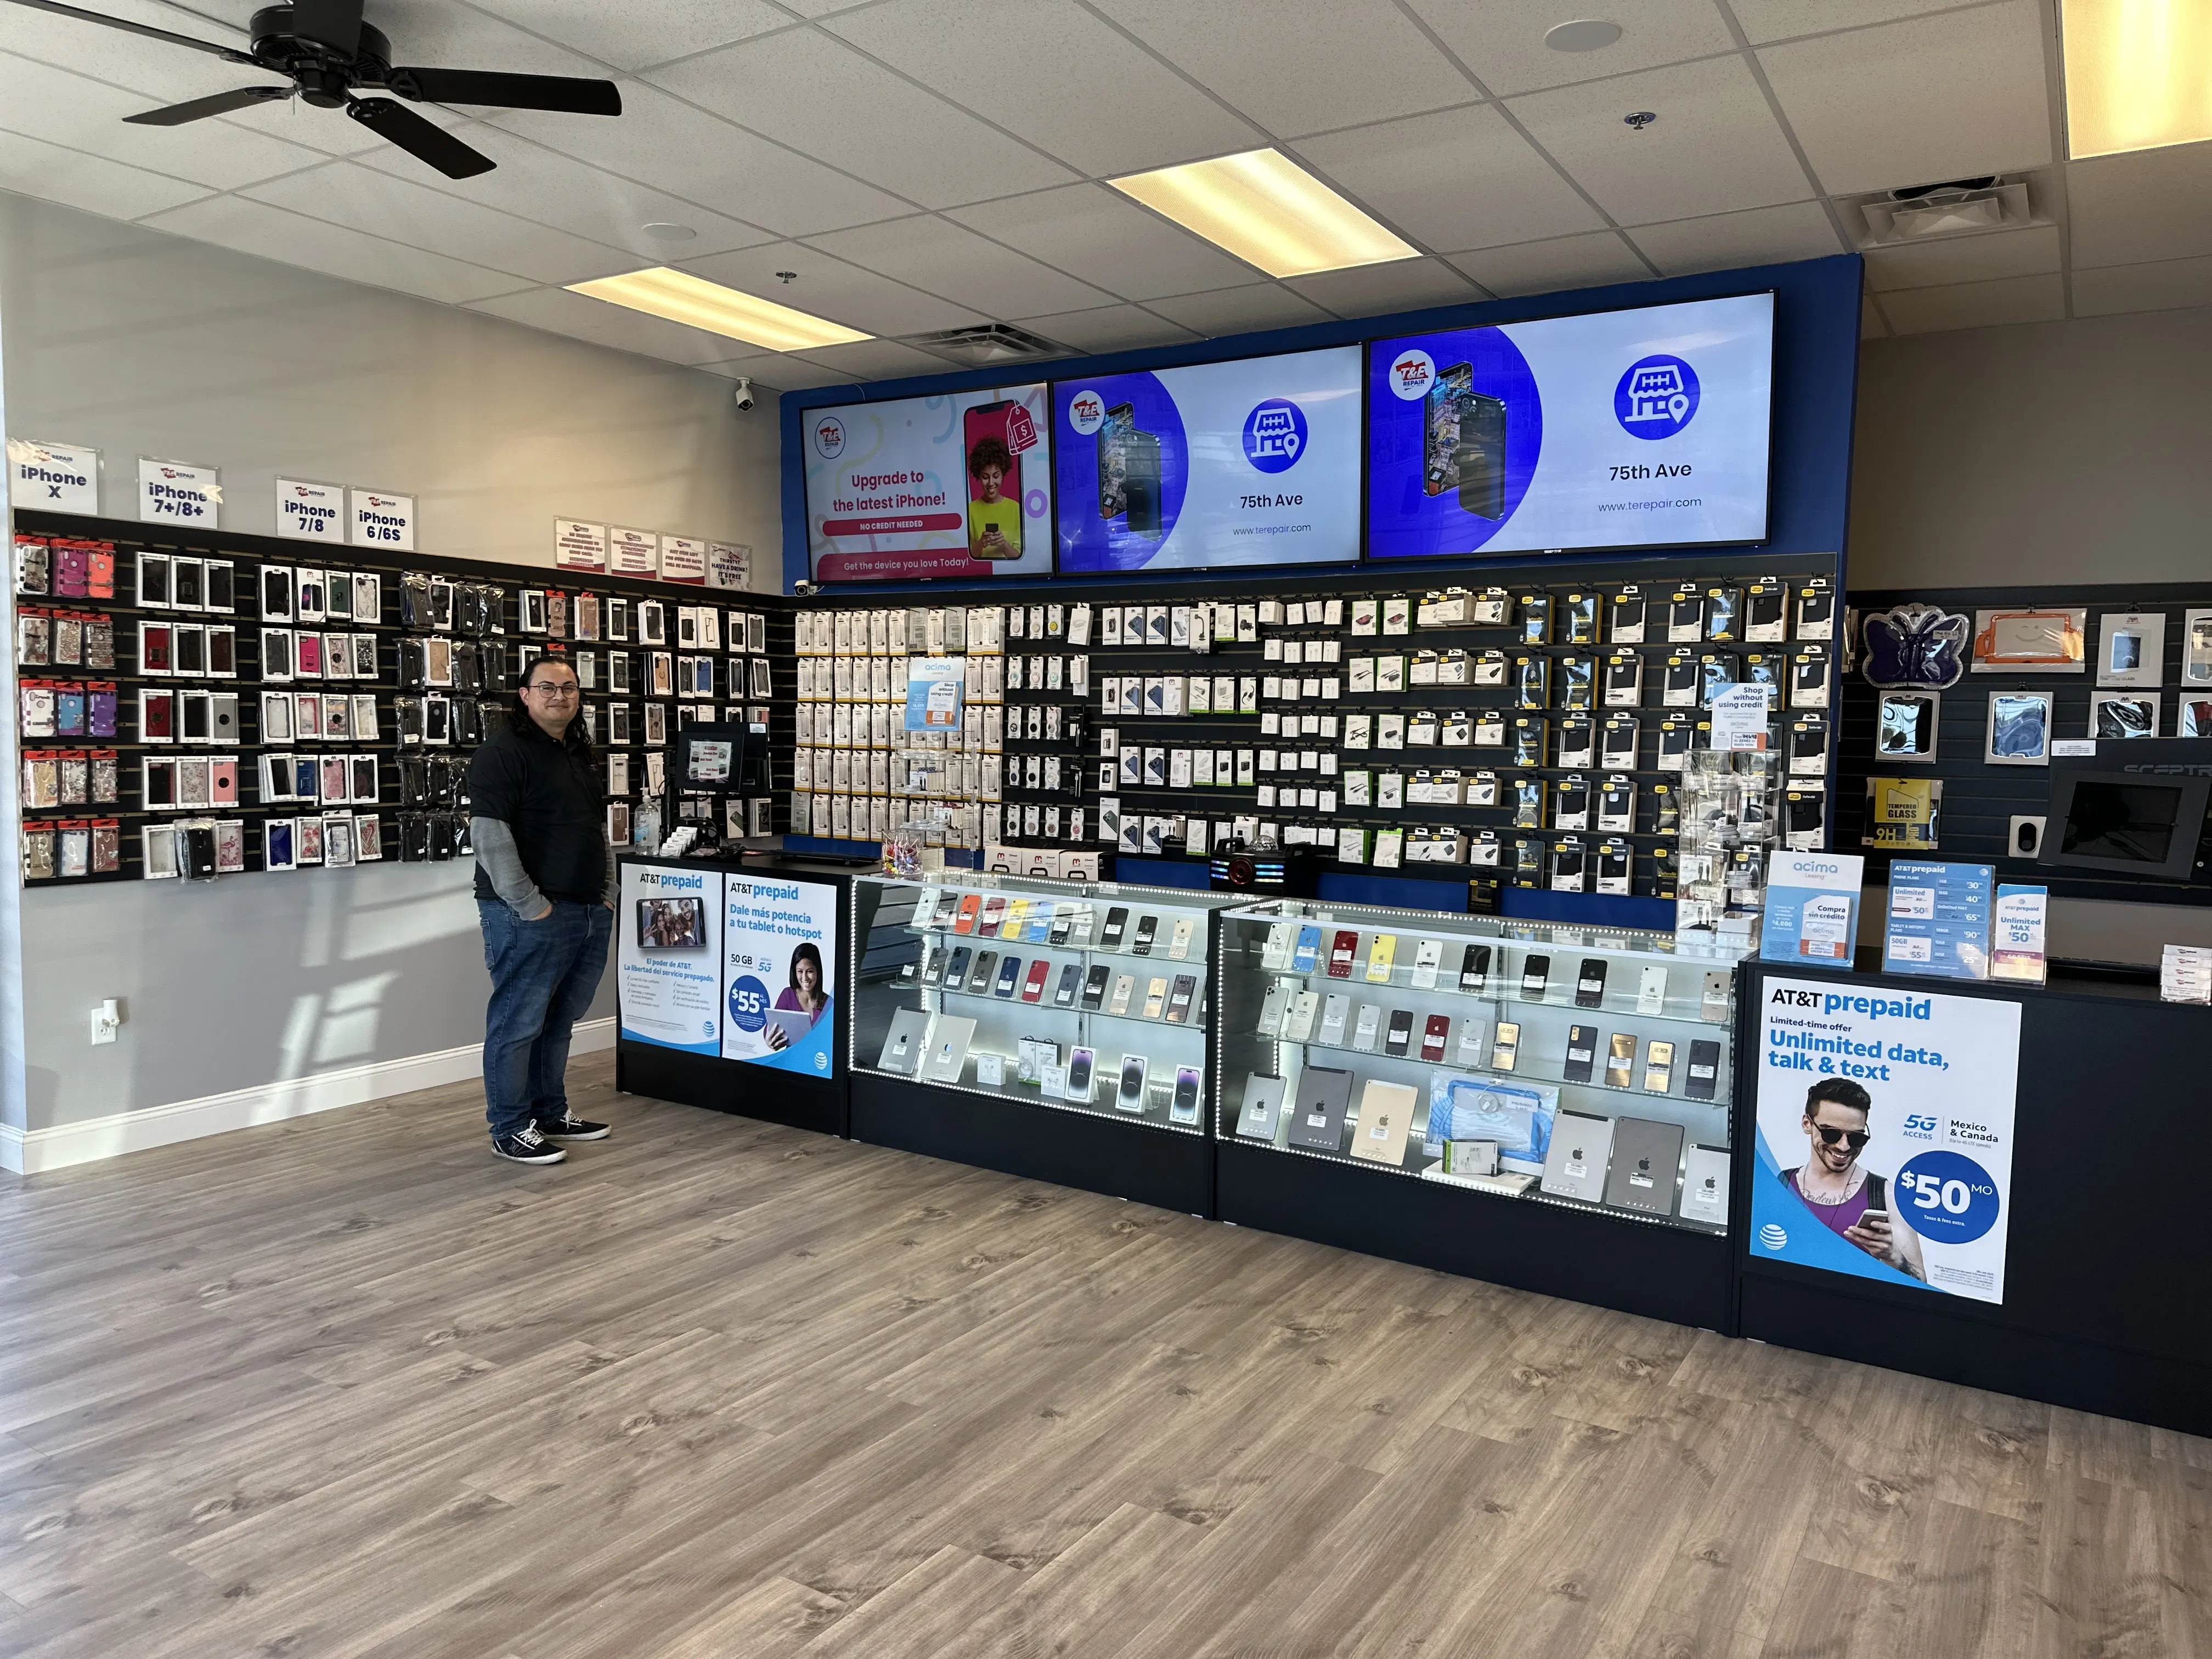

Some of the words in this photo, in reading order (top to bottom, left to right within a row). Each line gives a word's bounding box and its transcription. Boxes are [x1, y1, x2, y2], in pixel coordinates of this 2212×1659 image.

[1401, 366, 1426, 380] T&E
[1078, 405, 1097, 416] T&E
[823, 431, 839, 441] T&E
[21, 465, 87, 486] iPhone
[1610, 465, 1650, 481] 75th
[1655, 464, 1692, 478] Ave
[852, 471, 908, 491] Upgrade
[911, 471, 924, 482] to
[48, 486, 61, 499] X
[149, 482, 208, 502] iPhone
[154, 499, 204, 516] 7+/8+
[285, 500, 336, 518] iPhone
[833, 499, 854, 512] the
[857, 496, 893, 510] latest
[896, 492, 946, 508] iPhone!
[1240, 495, 1271, 509] 75th
[1275, 494, 1303, 506] Ave
[1599, 499, 1701, 512] www.terepair.com
[299, 517, 324, 532] 7/8
[359, 510, 405, 527] iPhone
[1233, 524, 1311, 535] www.terepair.com
[844, 562, 858, 571] Get
[860, 561, 873, 569] the
[874, 560, 901, 569] device
[903, 561, 918, 571] you
[921, 558, 938, 567] love
[940, 557, 969, 568] Today!
[1888, 810, 1916, 818] GLASS
[1876, 828, 1896, 840] 9H
[1793, 861, 1838, 873] acima
[640, 873, 660, 884] AT&T
[661, 874, 702, 890] prepaid
[731, 883, 752, 894] AT&T
[753, 885, 798, 901] prepaid
[730, 904, 749, 915] Dale
[752, 907, 770, 918] más
[772, 911, 811, 924] potencia
[2001, 917, 2041, 925] Unlimited
[737, 918, 746, 929] tu
[748, 920, 776, 933] tablet
[786, 924, 822, 940] hotspot
[2009, 932, 2029, 943] $50
[731, 954, 740, 963] 50
[742, 955, 752, 965] GB
[758, 962, 771, 972] 5G
[631, 964, 652, 973] libertad
[684, 973, 714, 982] prepagado.
[732, 988, 760, 1013] $55
[1771, 989, 1822, 1008] AT&T
[1825, 994, 1931, 1020] prepaid
[1770, 1016, 1827, 1030] Limited-time
[1830, 1024, 1852, 1032] offer
[1770, 1029, 1882, 1058] Unlimited
[1888, 1043, 1949, 1071] data,
[1768, 1051, 1813, 1071] talk
[1818, 1057, 1836, 1074] &
[1840, 1059, 1890, 1081] text
[1904, 1114, 1938, 1131] 5G
[1950, 1120, 1987, 1132] Mexico
[1903, 1131, 1932, 1140] ACCESS
[1960, 1130, 1999, 1143] Canada
[1901, 1170, 1971, 1214] $50
[1971, 1183, 1993, 1195] MO
